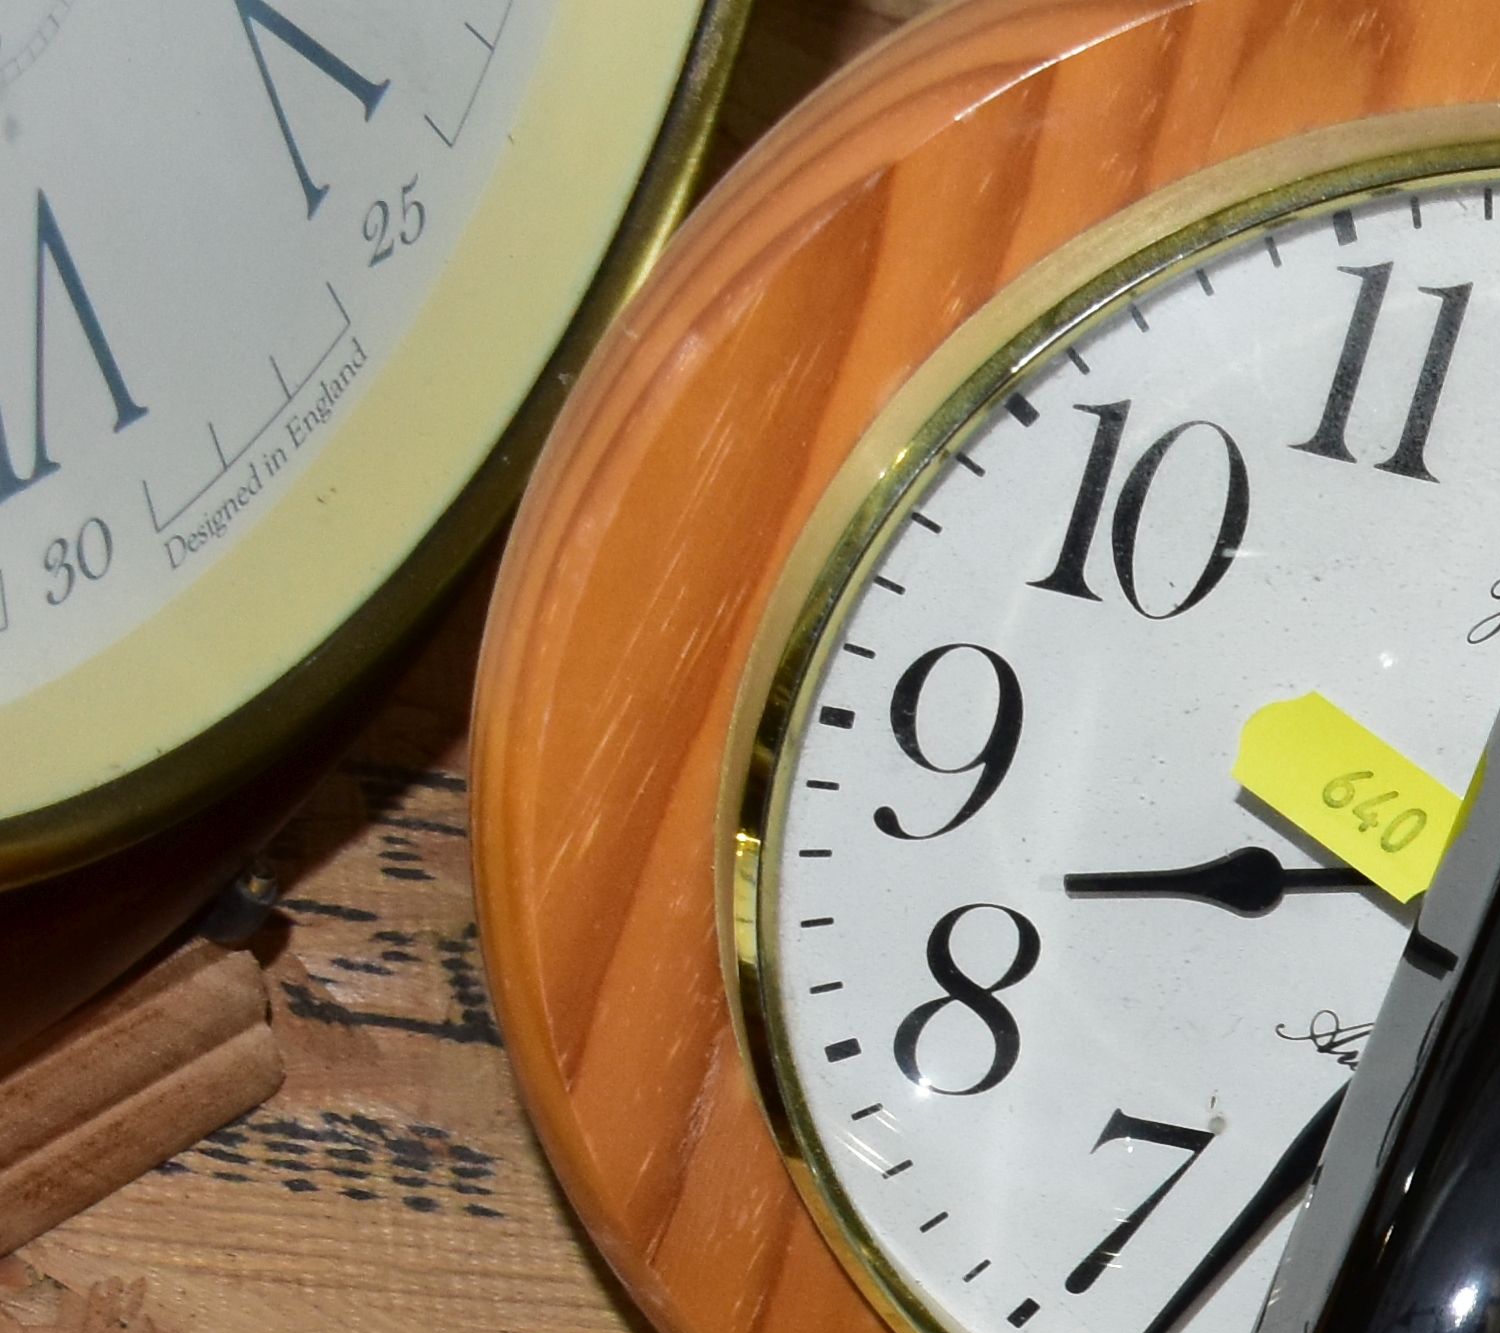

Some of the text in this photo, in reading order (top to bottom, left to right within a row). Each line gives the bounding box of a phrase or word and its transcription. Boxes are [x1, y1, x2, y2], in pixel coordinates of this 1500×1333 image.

[362, 172, 427, 267] 25
[164, 338, 369, 571] Designed in England
[1287, 260, 1474, 485] 11
[43, 516, 113, 606] 30
[1026, 399, 1250, 620] 10
[873, 643, 1024, 841] 9
[1321, 768, 1429, 855] 640
[893, 903, 1042, 1096] 8
[1064, 1107, 1216, 1294] 7
